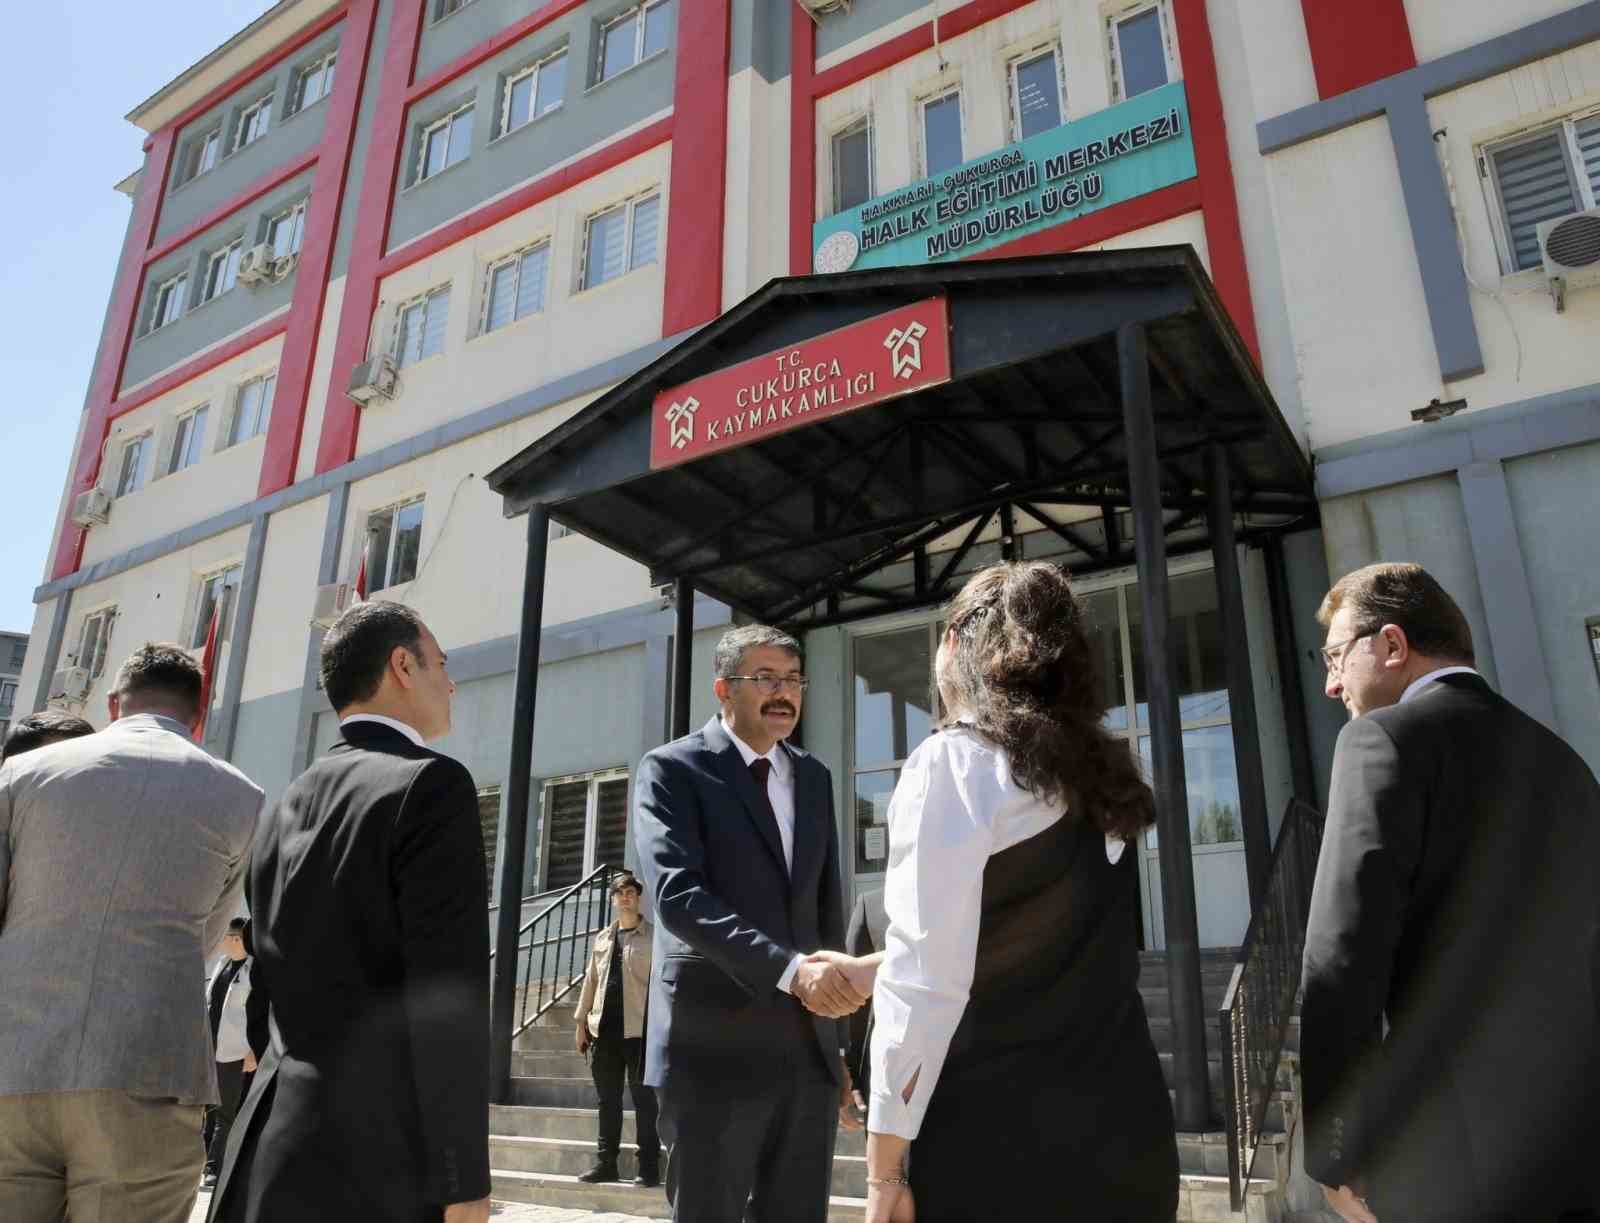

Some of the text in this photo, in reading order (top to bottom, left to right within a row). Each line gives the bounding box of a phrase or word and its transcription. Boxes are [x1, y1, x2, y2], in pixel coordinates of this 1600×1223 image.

[860, 109, 1182, 250] HALK EĞİTİMİ MERKEZİ
[926, 173, 1104, 258] MÜDÜRLÜĞÜ
[707, 372, 876, 441] KAYMAKAMLIĞI
